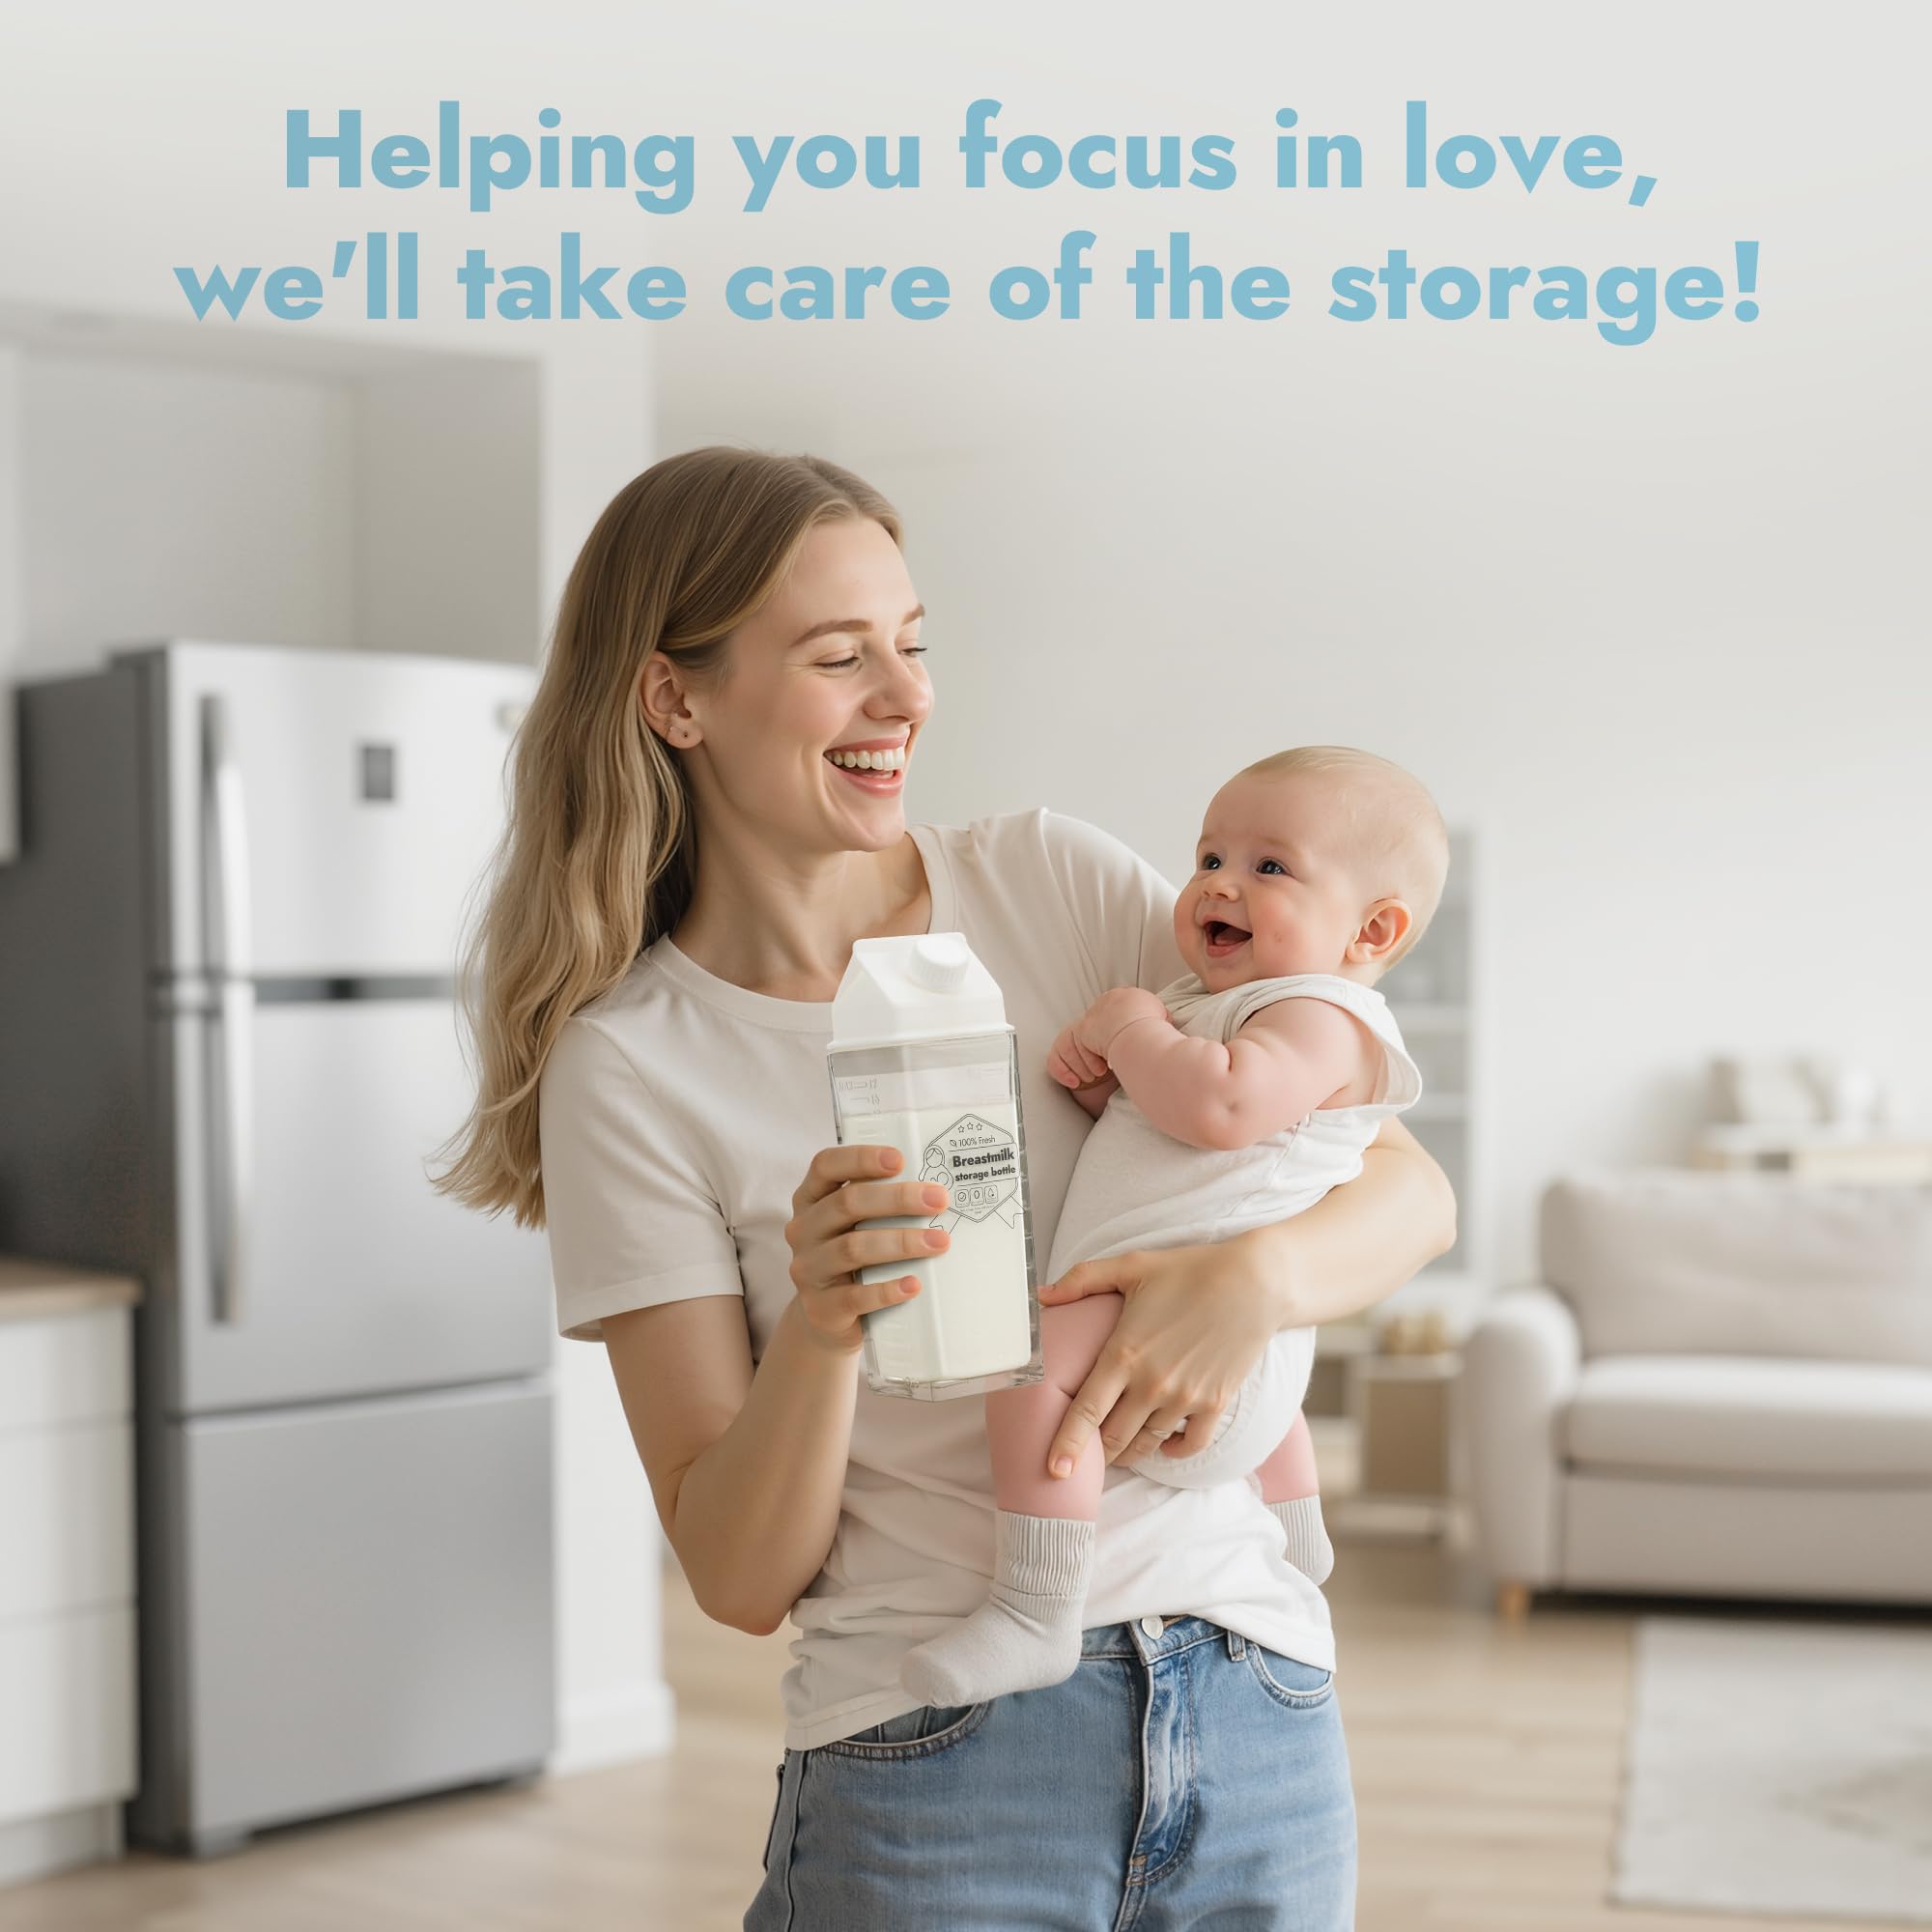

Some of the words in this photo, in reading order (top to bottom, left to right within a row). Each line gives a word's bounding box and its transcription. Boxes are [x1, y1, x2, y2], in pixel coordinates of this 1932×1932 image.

[958, 1137, 977, 1147] 100%
[978, 1135, 996, 1145] Fresh
[952, 1148, 1014, 1167] Breastmilk
[955, 1171, 989, 1181] storage
[991, 1164, 1016, 1176] bottle
